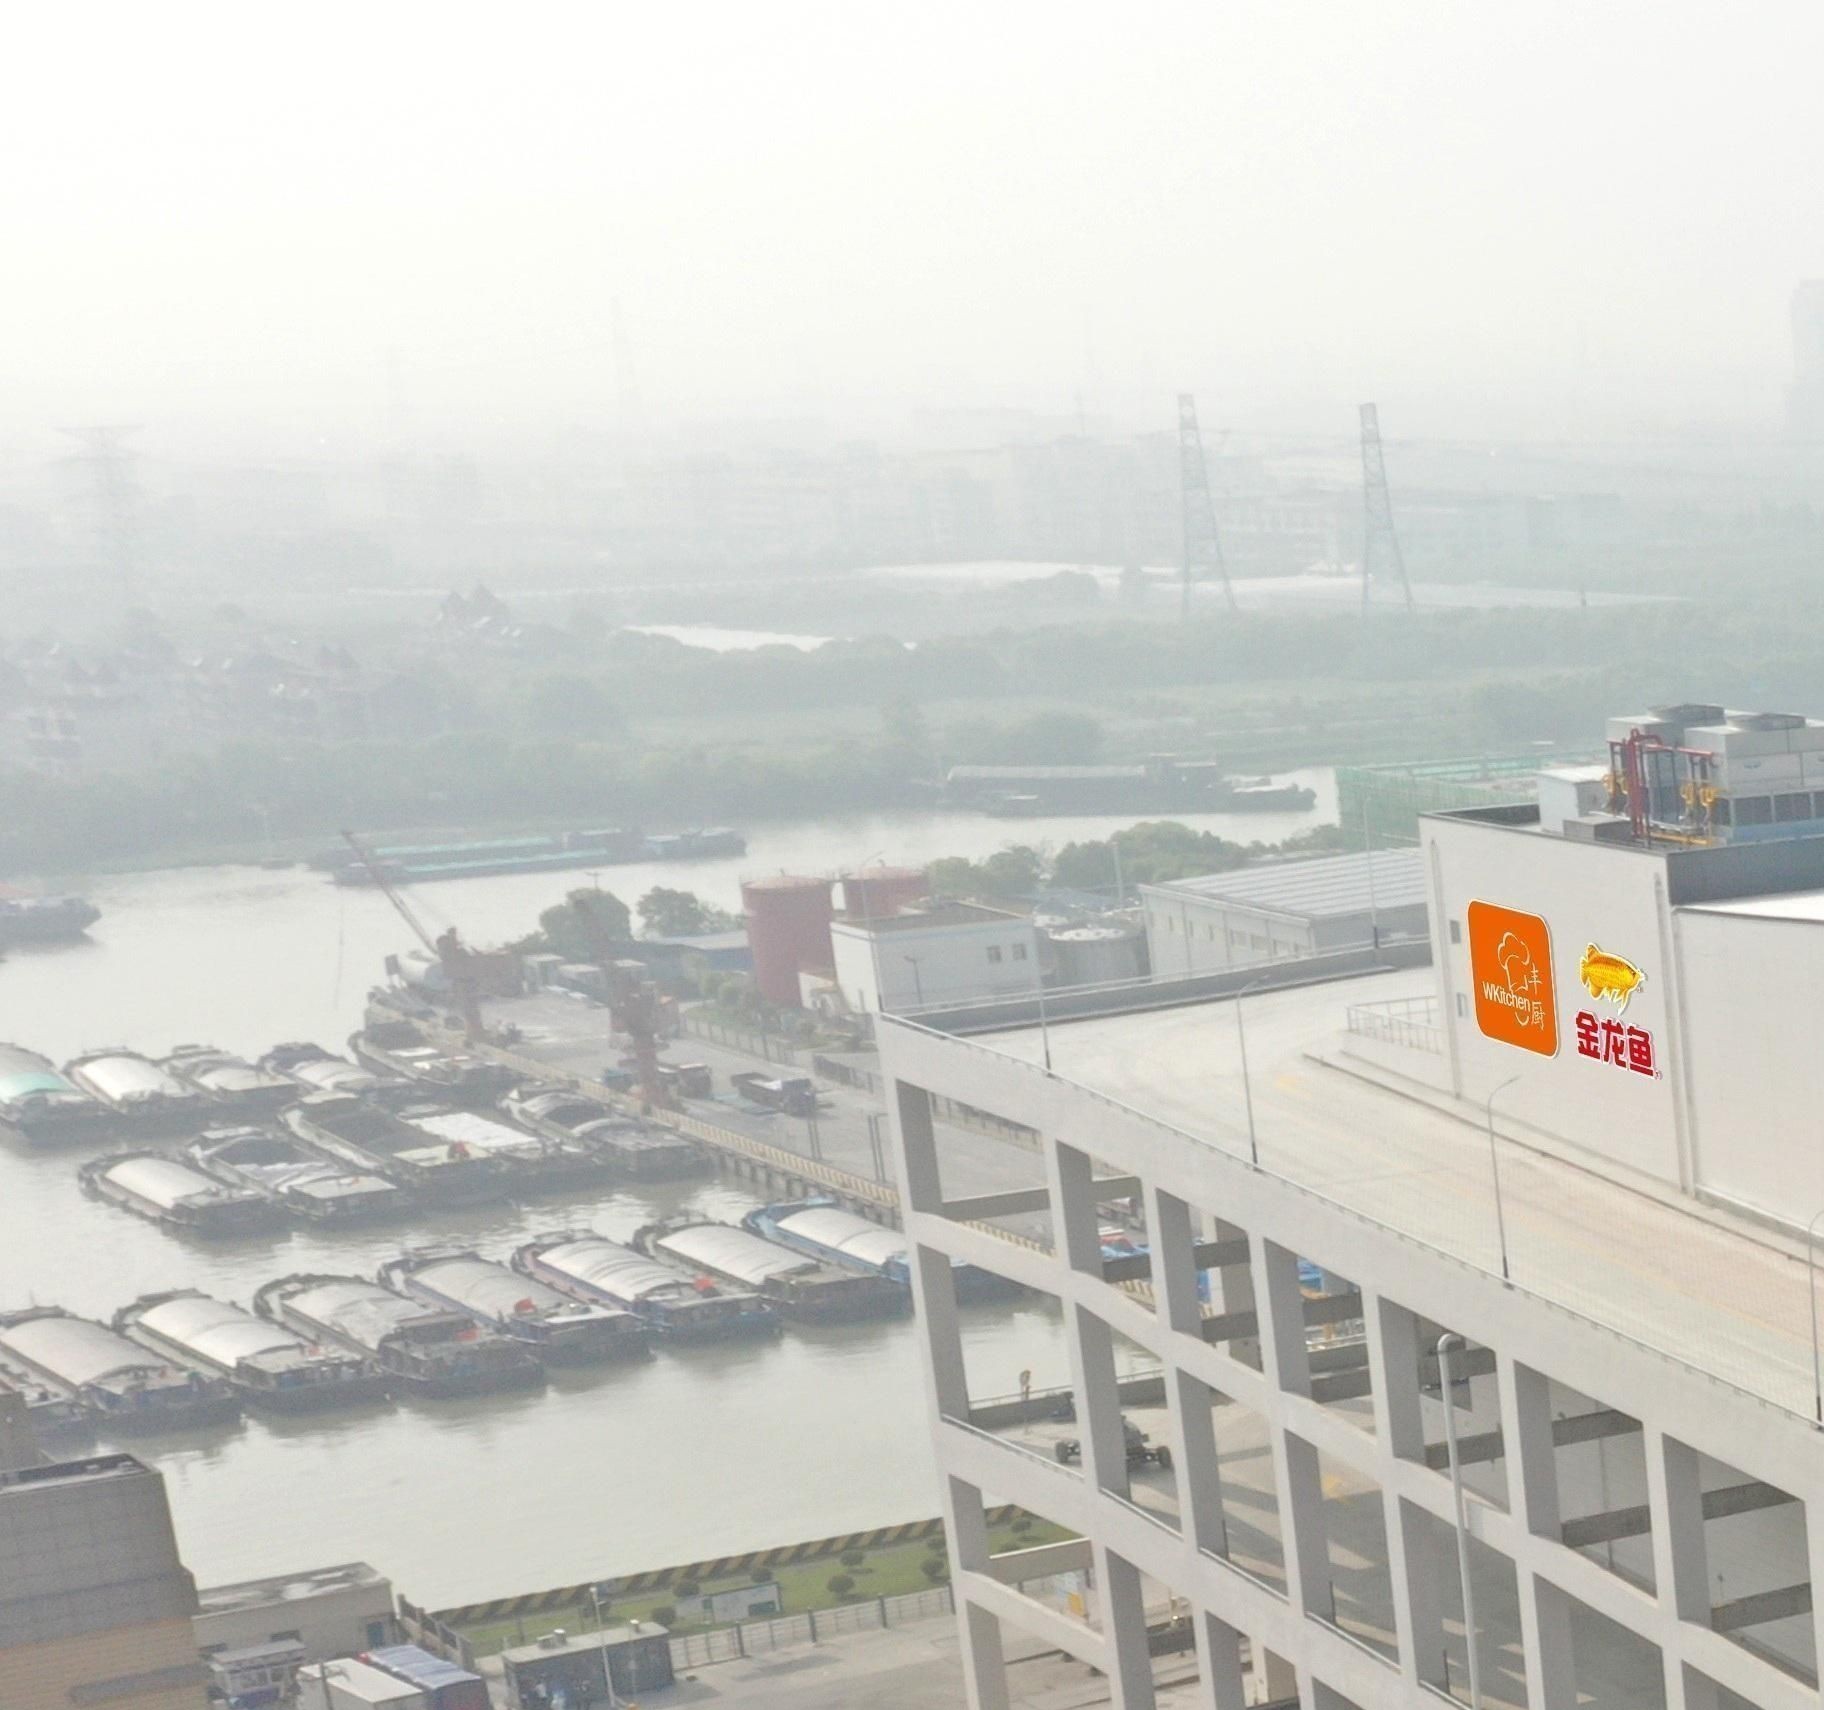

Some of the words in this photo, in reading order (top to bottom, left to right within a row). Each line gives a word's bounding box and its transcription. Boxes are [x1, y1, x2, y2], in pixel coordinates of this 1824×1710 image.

[1482, 981, 1531, 1012] WKitchen
[1575, 1010, 1654, 1077] 金龙鱼
